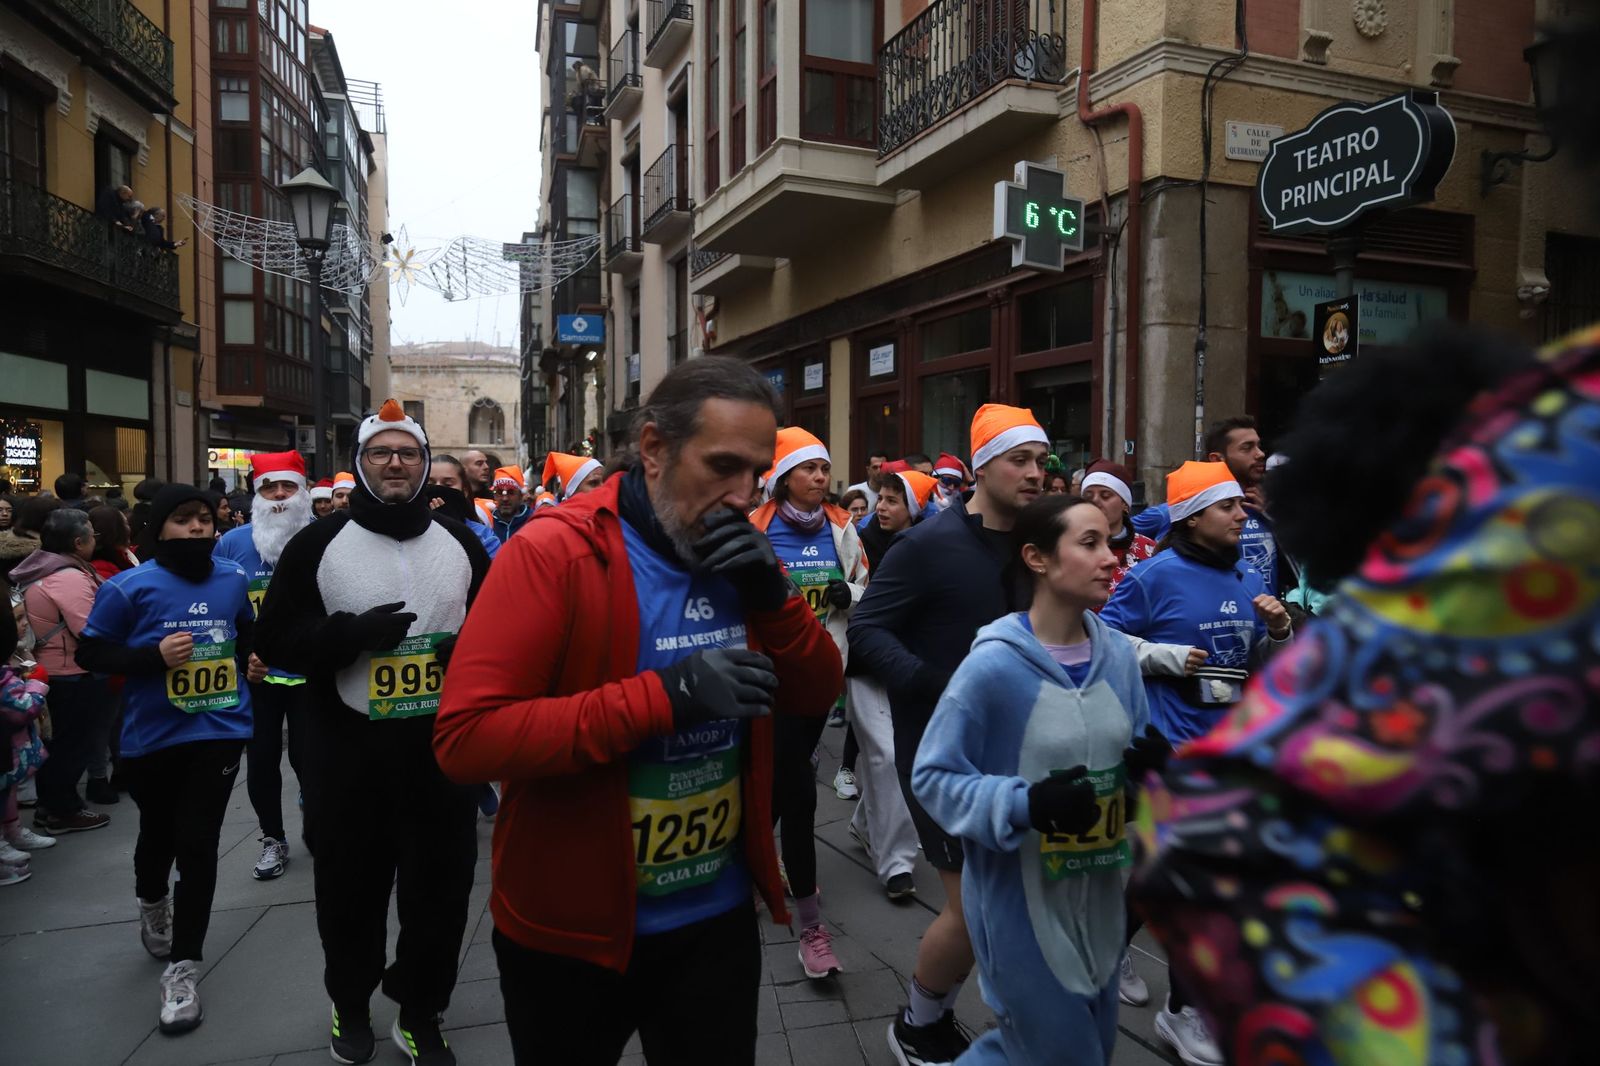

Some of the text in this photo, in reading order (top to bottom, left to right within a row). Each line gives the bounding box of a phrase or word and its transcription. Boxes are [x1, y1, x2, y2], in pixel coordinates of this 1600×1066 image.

[1246, 128, 1271, 138] CALLE
[1251, 138, 1262, 147] DE
[1293, 126, 1379, 172] TEATRO
[1281, 159, 1395, 211] PRINCIPAL
[1026, 202, 1076, 235] 6 °C
[1299, 285, 1313, 298] Un
[1376, 290, 1407, 304] salud
[561, 334, 601, 342] Samsonite
[6, 435, 37, 449] MÁXIMA
[5, 447, 37, 458] TASACIÓN
[1245, 519, 1260, 530] 46
[801, 545, 819, 557] 46
[188, 602, 209, 615] 46
[684, 597, 715, 622] 46
[1220, 600, 1238, 614] 46
[179, 620, 213, 628] SILVESTRE
[1199, 622, 1212, 630] SAN
[1213, 620, 1244, 629] SILVESTRE
[655, 636, 678, 651] SAN
[678, 627, 729, 649] SILVESTRE
[172, 665, 229, 696] 606
[375, 661, 441, 697] 995
[188, 696, 236, 708] CAJA RURAL
[395, 699, 440, 711] CAJA RUR
[669, 760, 723, 782] FUNDACIÓN
[668, 780, 694, 792] CAJA
[695, 770, 723, 789] RURAL
[632, 798, 730, 864] 1252
[656, 866, 691, 886] CAJA
